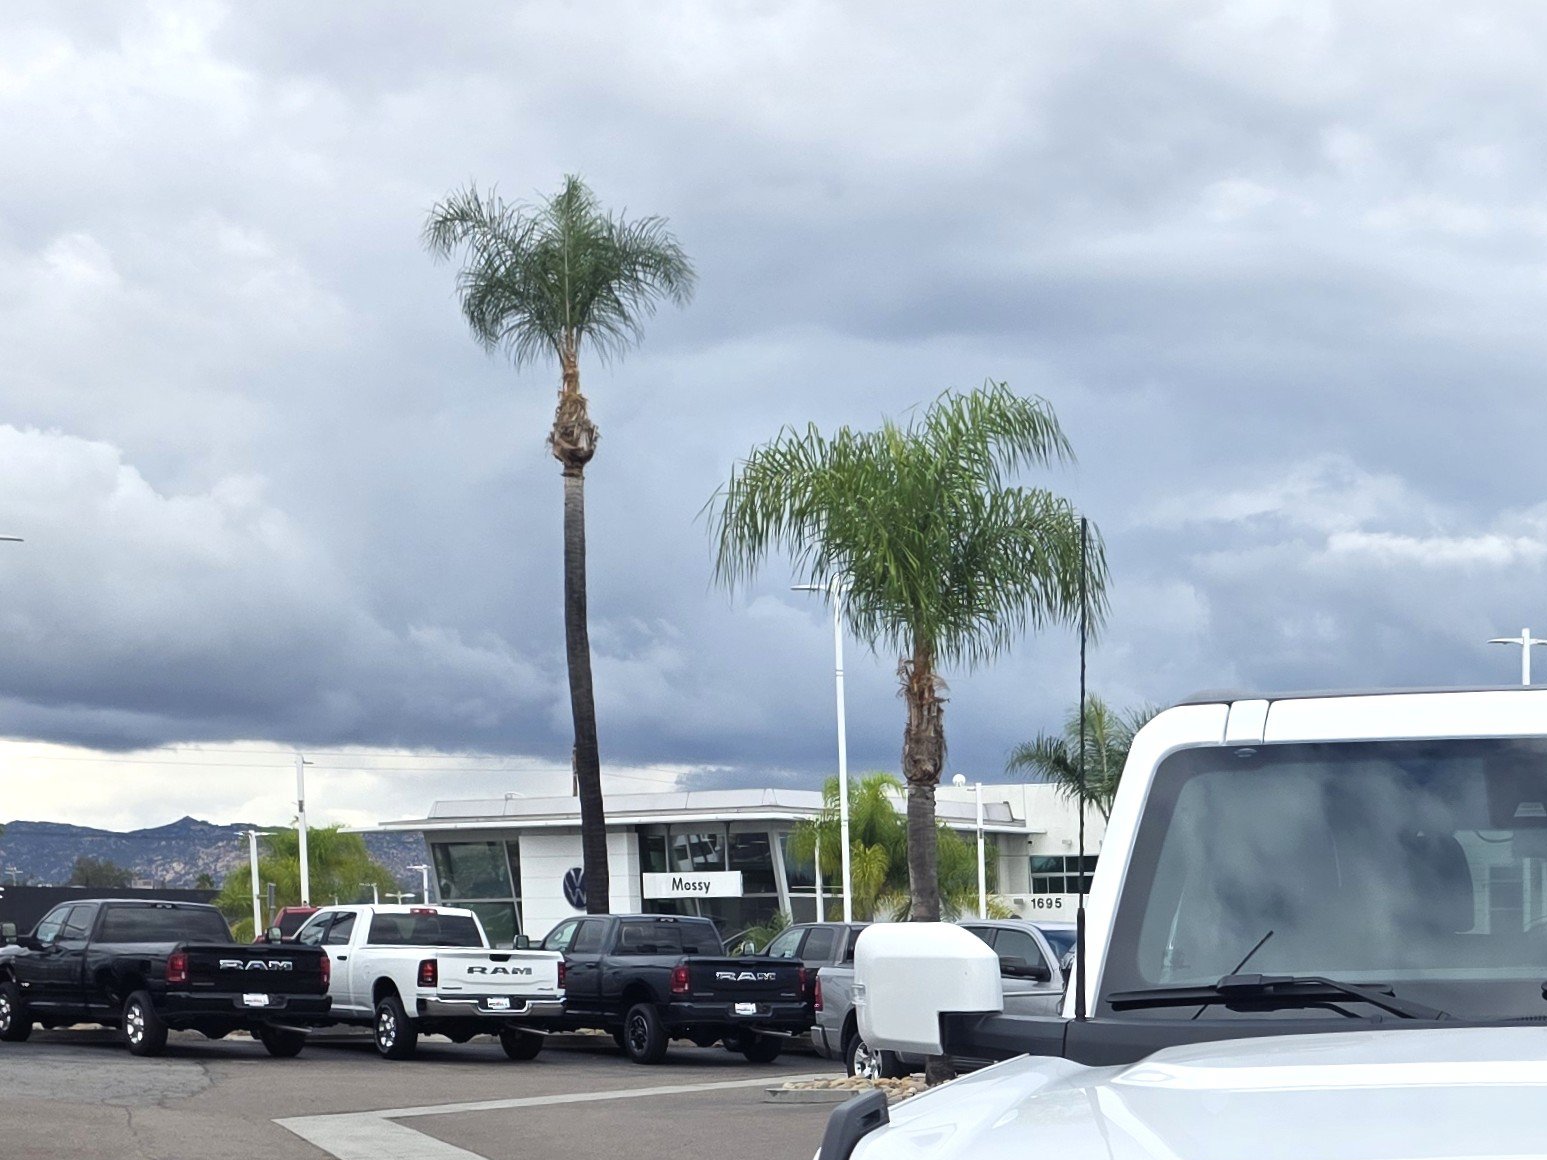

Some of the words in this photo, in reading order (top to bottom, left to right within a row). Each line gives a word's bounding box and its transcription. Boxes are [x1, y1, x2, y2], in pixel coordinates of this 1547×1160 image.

[671, 877, 711, 894] Mossy
[1031, 898, 1062, 909] 1695
[219, 959, 293, 971] RAM
[467, 966, 532, 975] RAM
[716, 971, 777, 981] RAM
